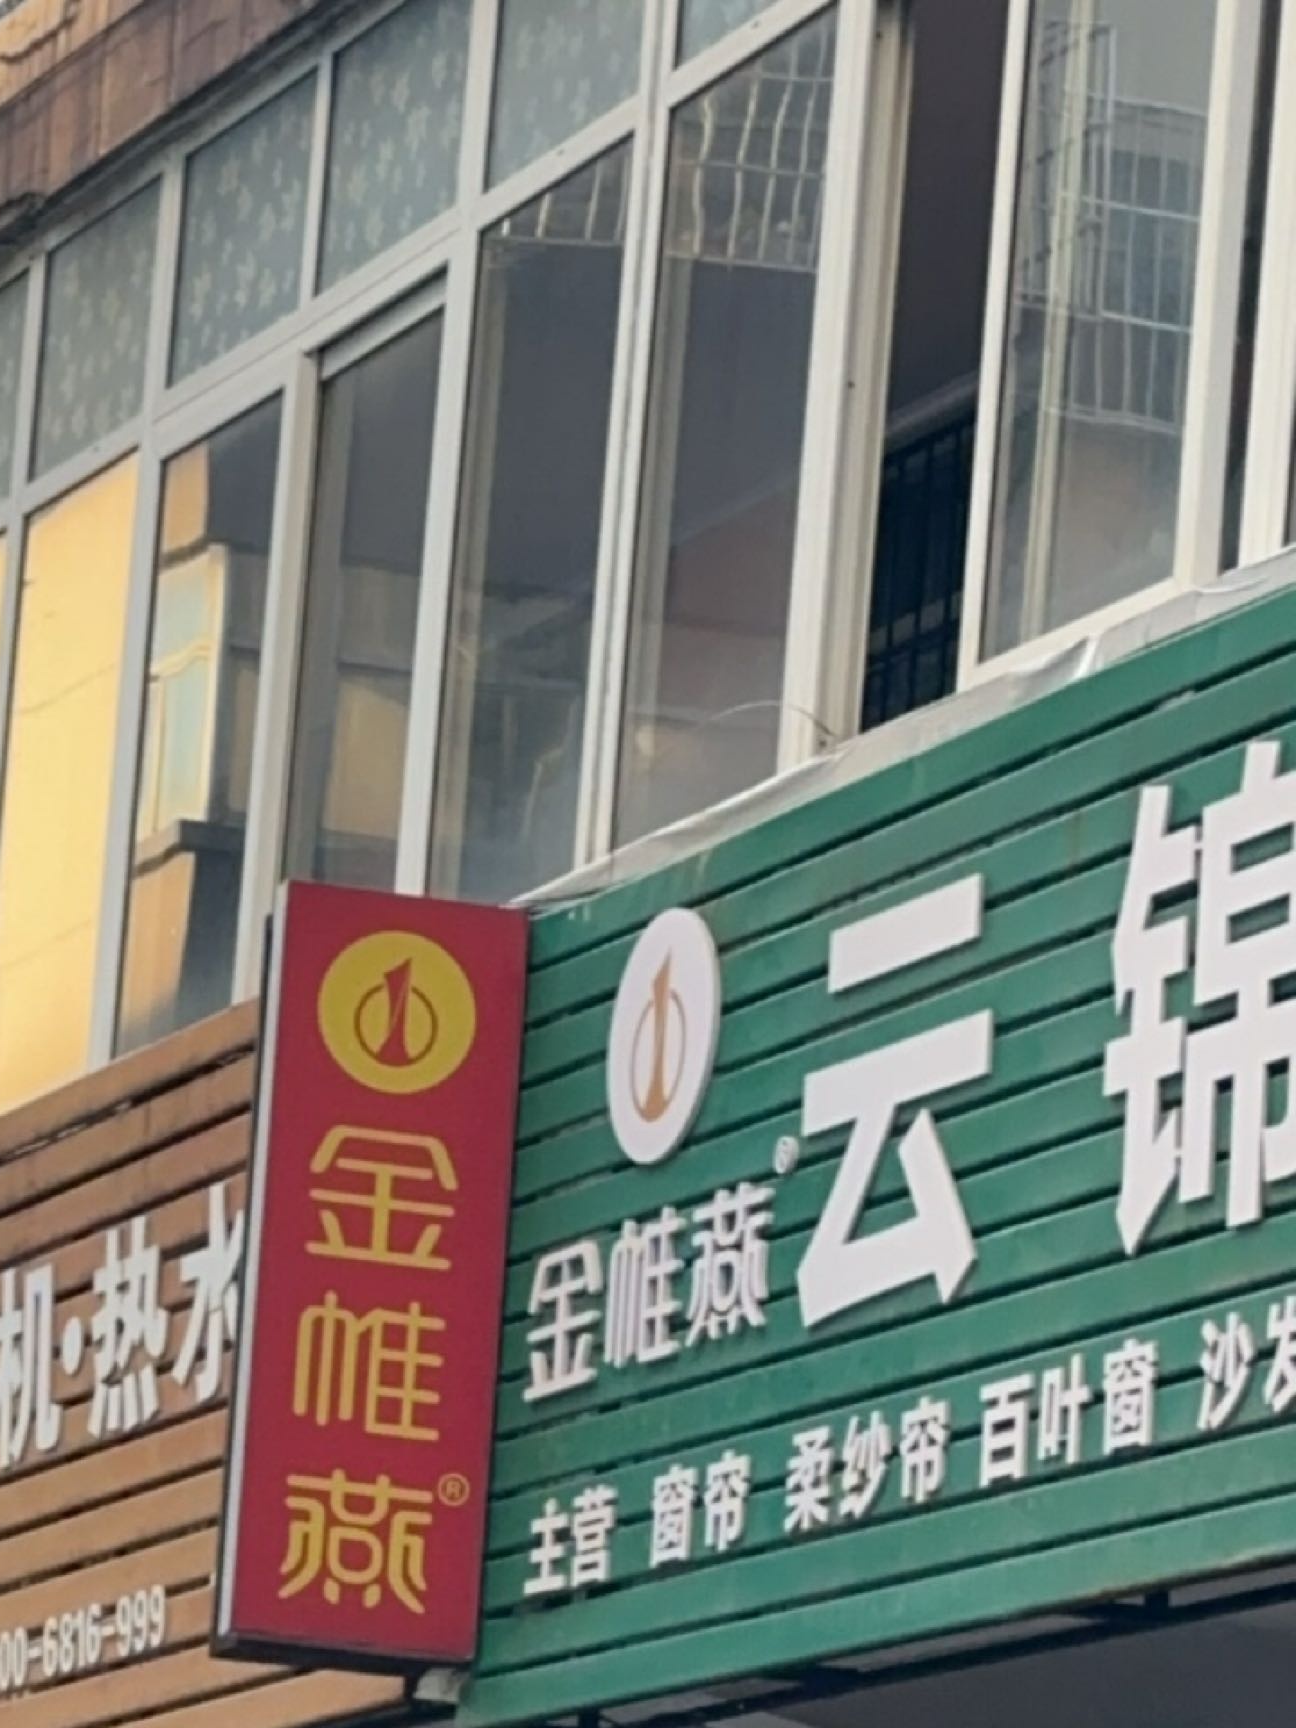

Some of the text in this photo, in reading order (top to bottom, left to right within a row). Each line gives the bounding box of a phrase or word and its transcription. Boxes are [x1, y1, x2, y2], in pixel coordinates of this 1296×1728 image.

[523, 1484, 618, 1597] 主营
[650, 1448, 751, 1569] 窗帘
[784, 1395, 951, 1533] 柔纱帘
[979, 1338, 1159, 1489] 百叶窗
